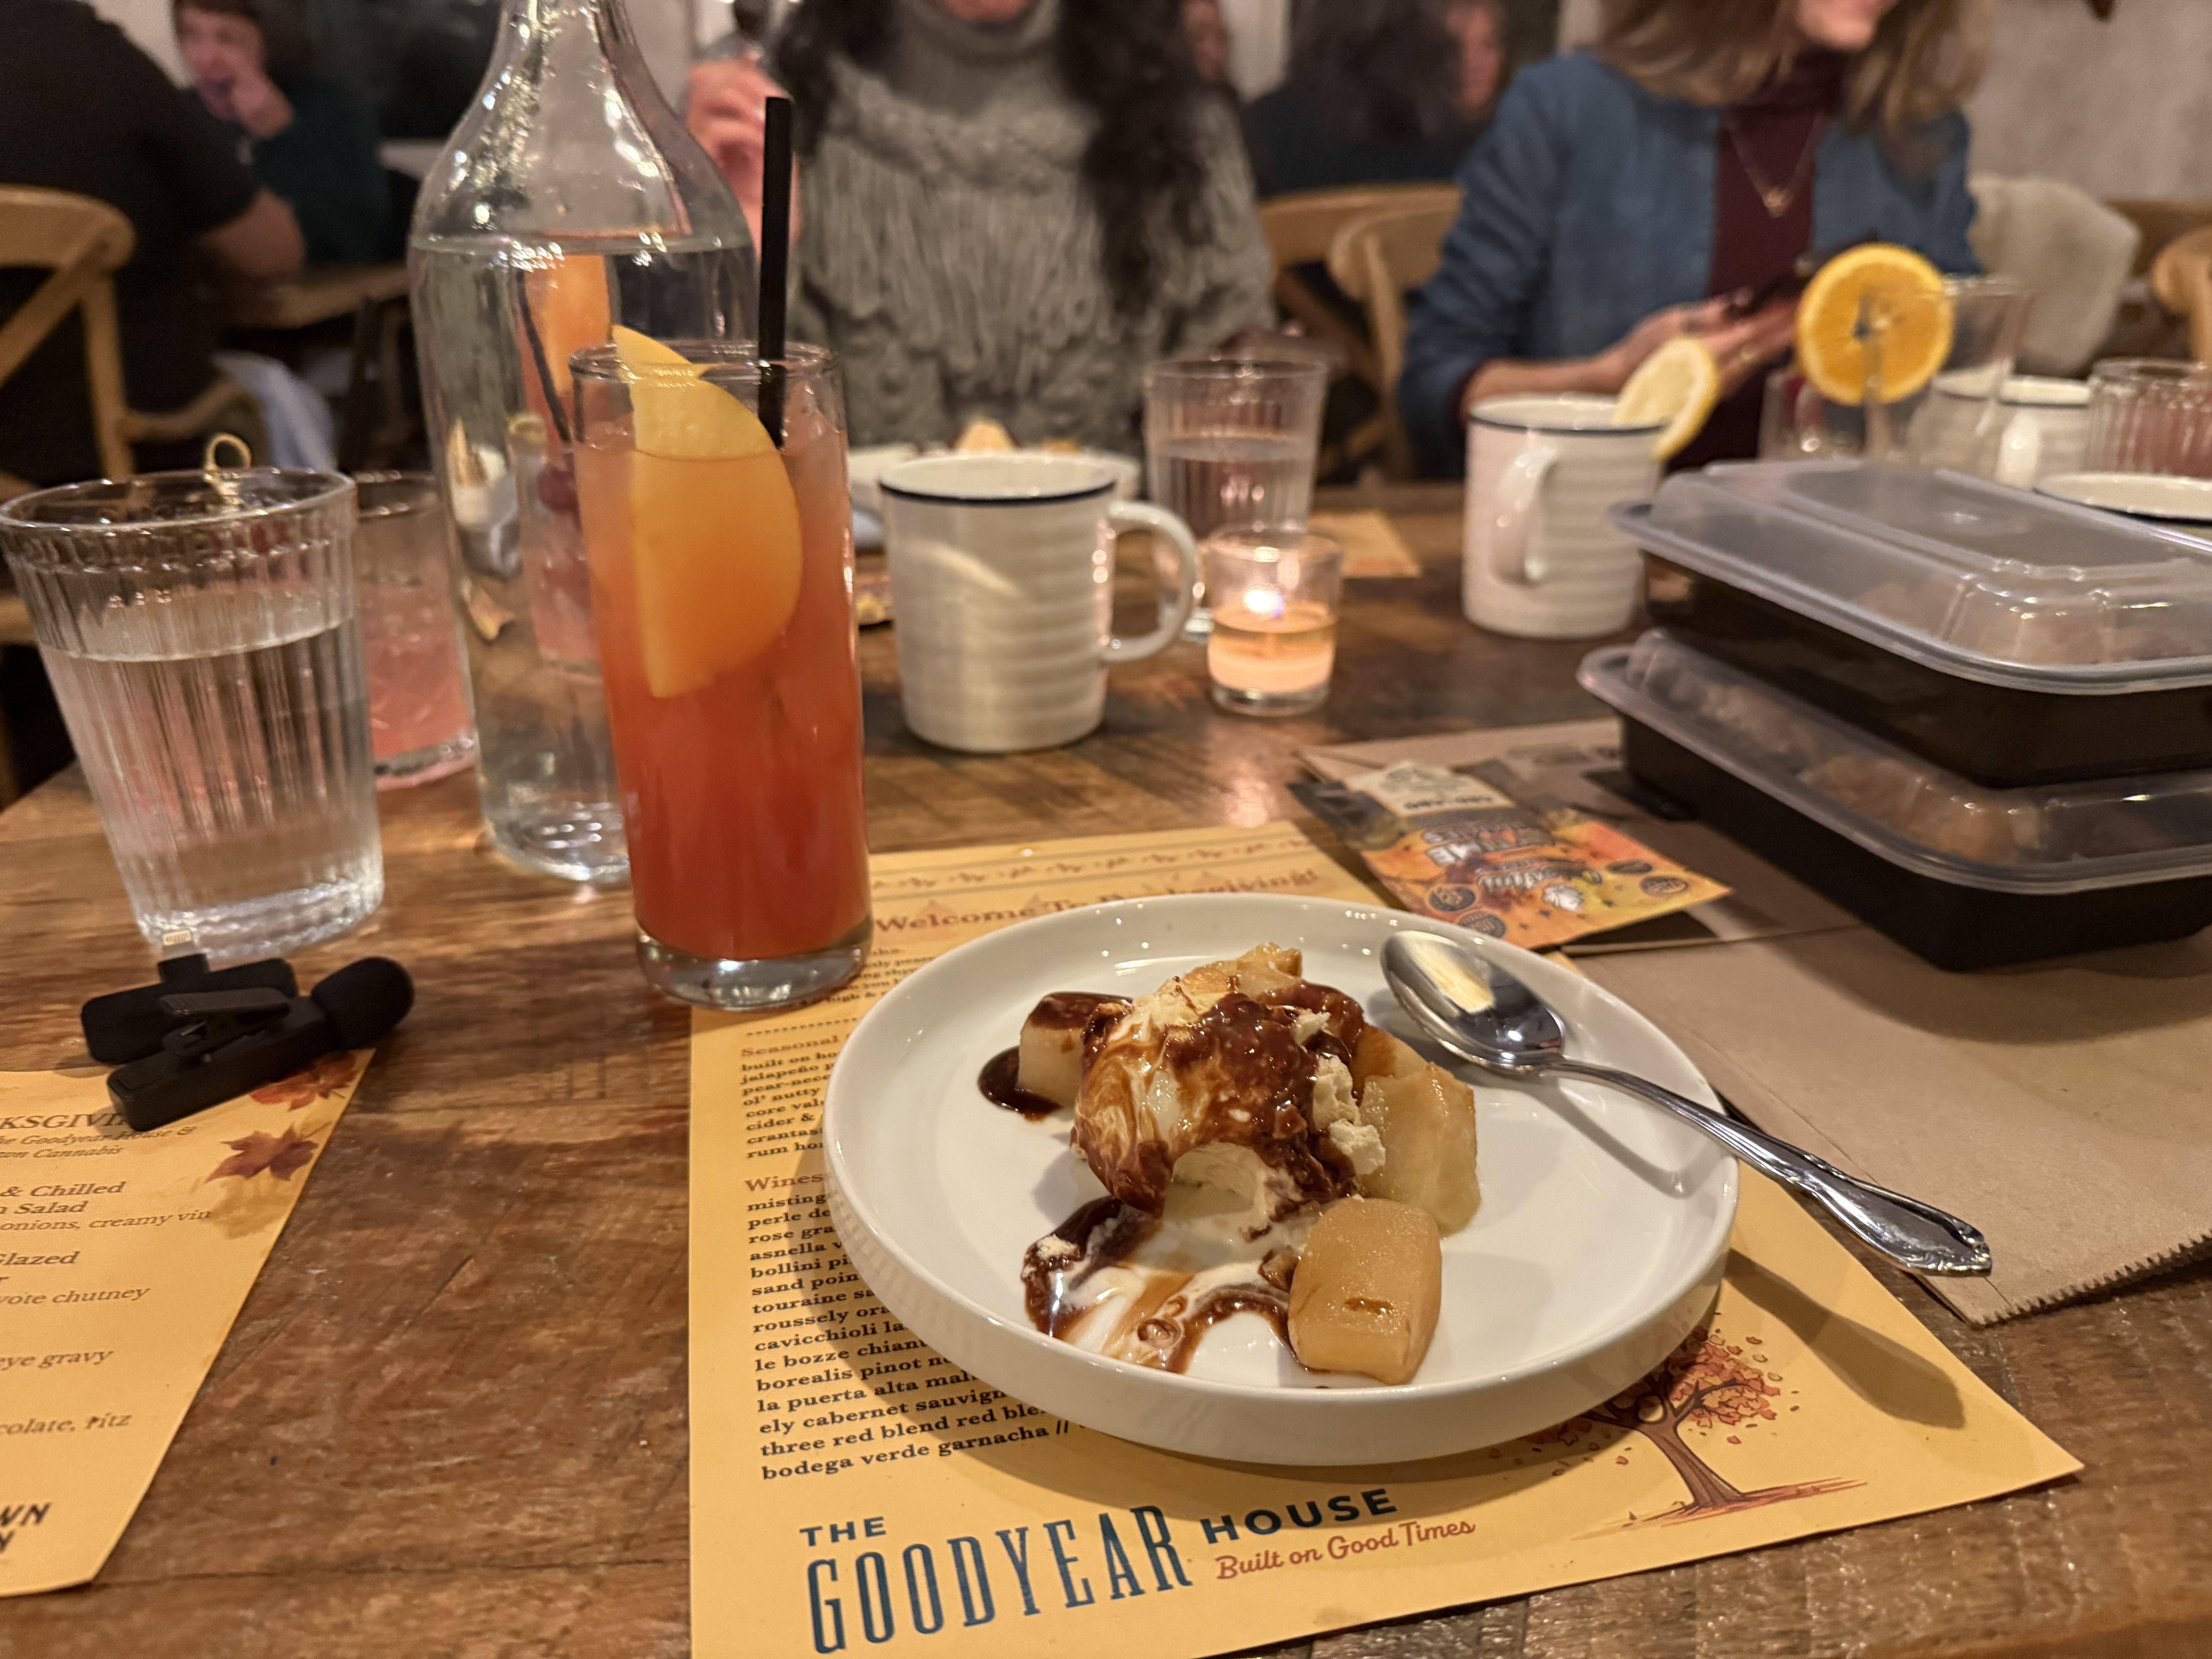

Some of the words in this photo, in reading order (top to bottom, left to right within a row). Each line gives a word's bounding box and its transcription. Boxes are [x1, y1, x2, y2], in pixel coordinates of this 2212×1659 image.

[741, 1035, 839, 1057] Seasonal
[741, 1065, 819, 1085] jalapeño
[772, 1087, 821, 1101] nutty
[746, 1105, 786, 1118] core
[747, 1116, 795, 1131] cider
[800, 1113, 815, 1121] &
[33, 1146, 124, 1158] Cannabis
[747, 1146, 788, 1159] rum
[0, 1187, 24, 1197] &
[30, 1182, 126, 1197] Chilled
[745, 1173, 824, 1192] Wines
[14, 1201, 89, 1214] Salad
[89, 1214, 173, 1228] creamy
[178, 1210, 212, 1221] vin
[748, 1211, 802, 1230] perle
[749, 1231, 794, 1243] rose
[750, 1243, 827, 1261] asnella
[751, 1258, 821, 1279] bollini
[828, 1254, 852, 1270] pi
[52, 1288, 151, 1303] chutney
[752, 1278, 804, 1296] sand
[752, 1291, 847, 1314] touraine
[753, 1310, 849, 1333] roussely
[754, 1322, 878, 1352] cavicchioli
[38, 1351, 115, 1369] gravy
[755, 1359, 776, 1372] le
[783, 1349, 850, 1368] bozze
[757, 1368, 853, 1392] borealis
[859, 1358, 922, 1381] pinot
[757, 1400, 781, 1412] la
[787, 1389, 867, 1412] puerta
[874, 1381, 919, 1396] alta
[760, 1419, 795, 1435] ely
[802, 1401, 909, 1427] cabernet
[761, 1440, 825, 1457] three
[833, 1430, 874, 1446] red
[881, 1417, 950, 1439] blend
[955, 1409, 998, 1427] red
[1001, 1403, 1046, 1420] ble
[762, 1458, 854, 1480] bodega
[861, 1443, 930, 1465] verde
[938, 1426, 1049, 1457] garnacha
[1199, 1489, 1398, 1544] HOUSE
[799, 1516, 887, 1547] THE
[1215, 1550, 1285, 1580] Built
[1289, 1548, 1323, 1565] on
[1327, 1528, 1399, 1560] Good
[1398, 1520, 1477, 1546] Times
[805, 1504, 1194, 1655] GOODYEAR
